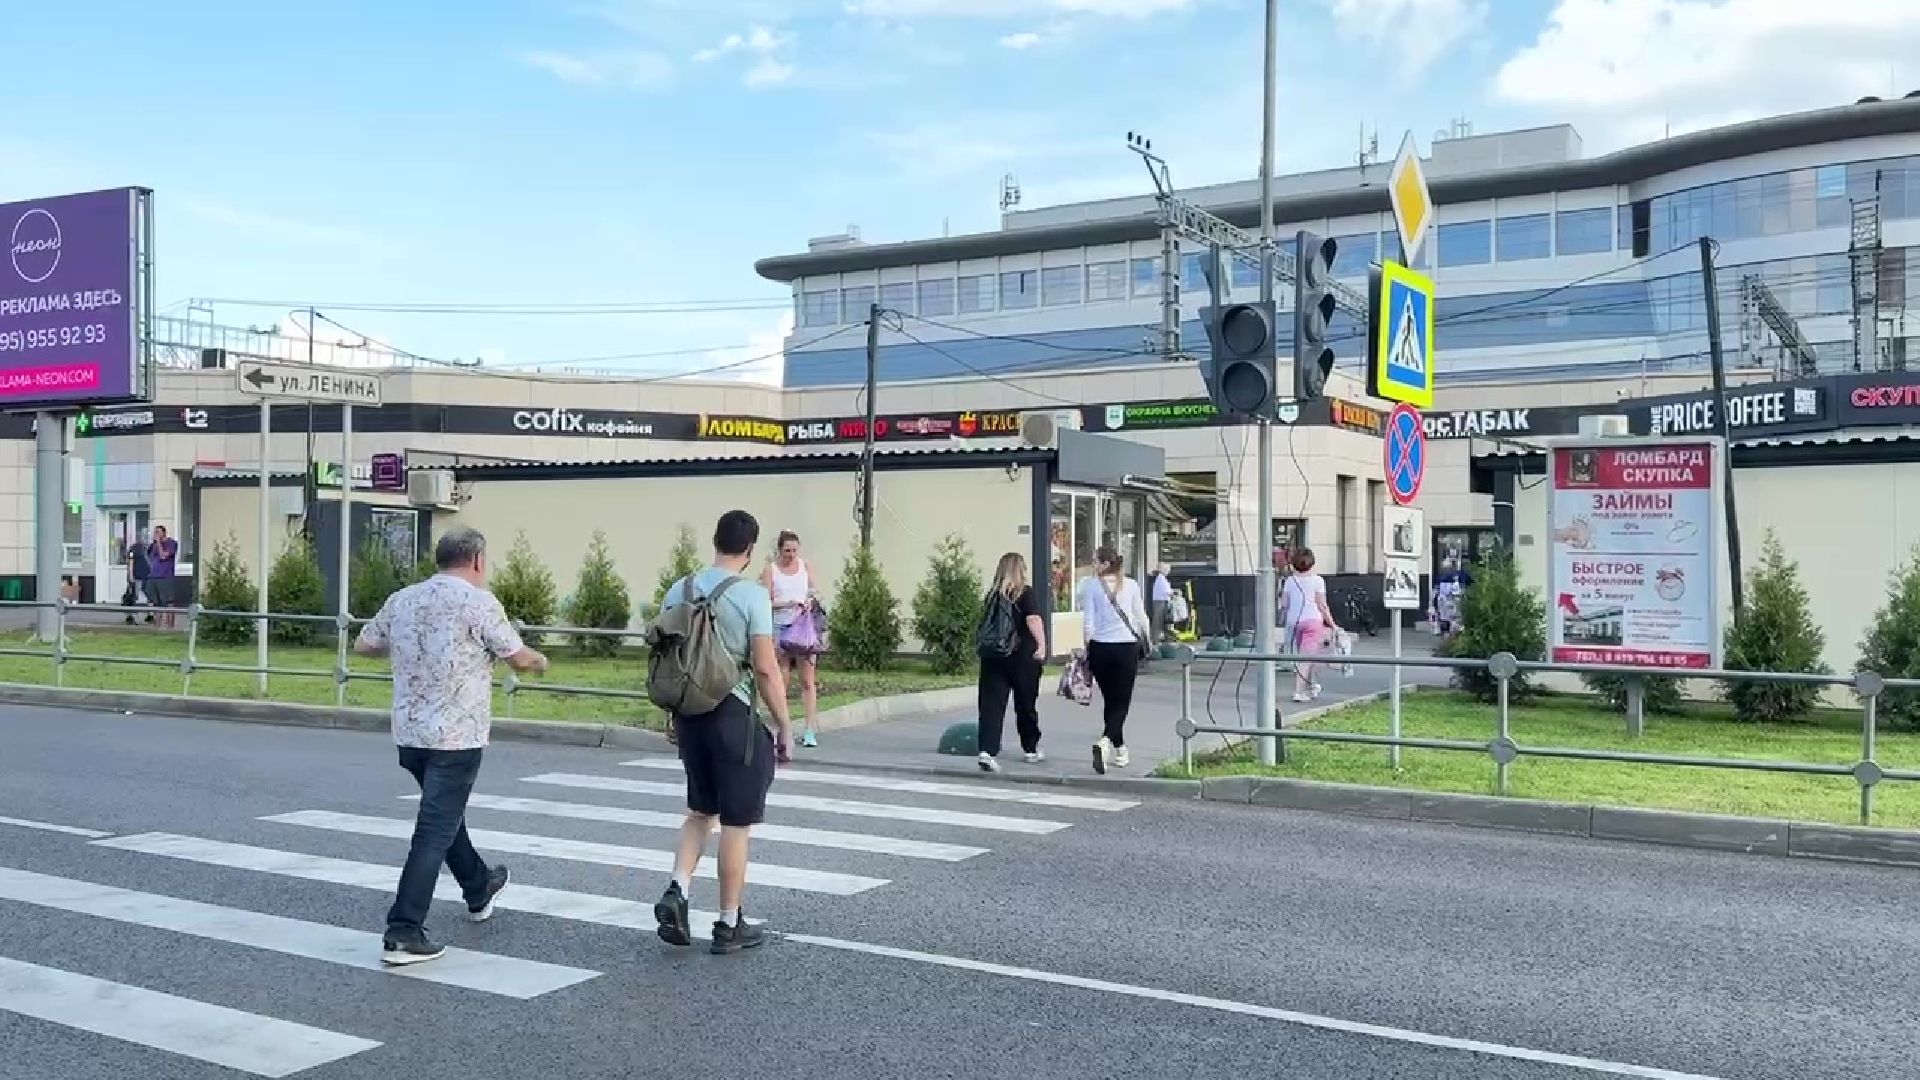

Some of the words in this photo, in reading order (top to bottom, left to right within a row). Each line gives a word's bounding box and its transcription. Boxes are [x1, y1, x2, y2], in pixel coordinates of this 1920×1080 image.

[0, 293, 70, 316] РЕКЛАМА
[73, 288, 121, 310] ЗДЕСЬ
[27, 328, 57, 348] 955
[60, 325, 81, 345] 92
[84, 324, 105, 343] 93
[0, 369, 94, 388] LAMA-NEON.COM
[307, 374, 376, 397] ЛЕНИНА
[513, 408, 583, 432] cofix
[1662, 400, 1714, 433] PRICE
[586, 419, 652, 437] кофейня
[708, 419, 785, 444] ЛОМБАРД
[789, 422, 834, 440] РЫБА
[839, 420, 889, 438] МЯО
[1614, 450, 1704, 466] ЛОМБАРД
[1623, 468, 1693, 482] СКУПКА
[1592, 491, 1673, 510] ЗАЙМЫ
[1572, 562, 1645, 574] БЫСТРОЕ
[1572, 576, 1645, 586] оформление
[1594, 588, 1602, 599] 5
